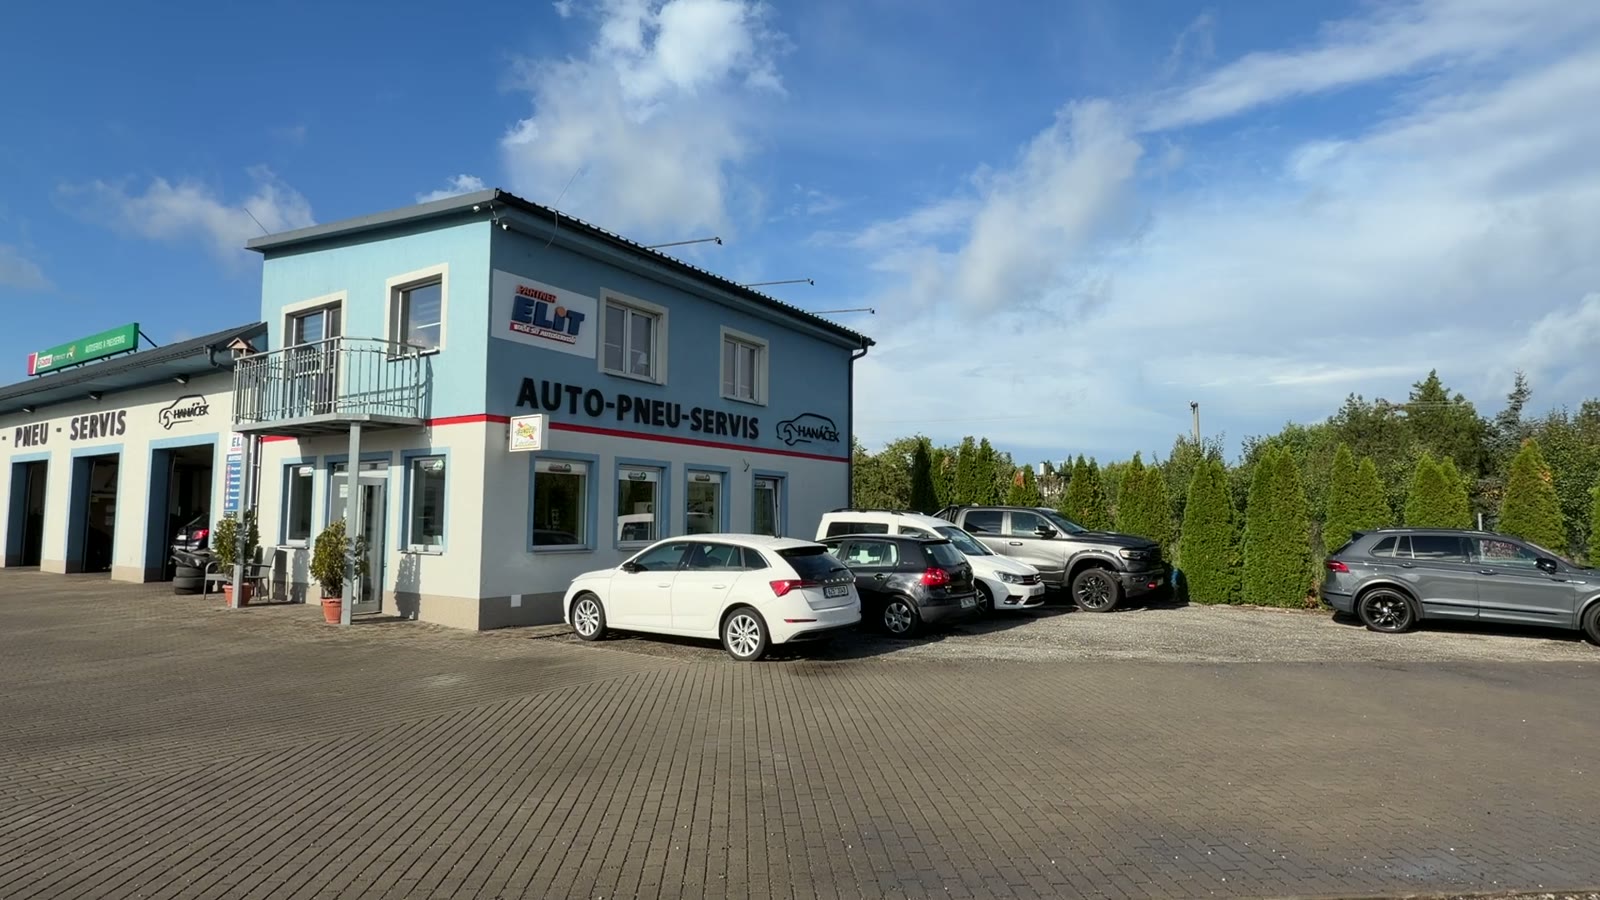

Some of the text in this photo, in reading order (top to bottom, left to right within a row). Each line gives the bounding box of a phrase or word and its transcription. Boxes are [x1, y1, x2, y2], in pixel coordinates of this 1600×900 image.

[516, 285, 557, 304] PARTNER
[14, 422, 49, 448] PNEU
[70, 410, 127, 441] SERVIS
[798, 425, 840, 443] HANÁČEK
